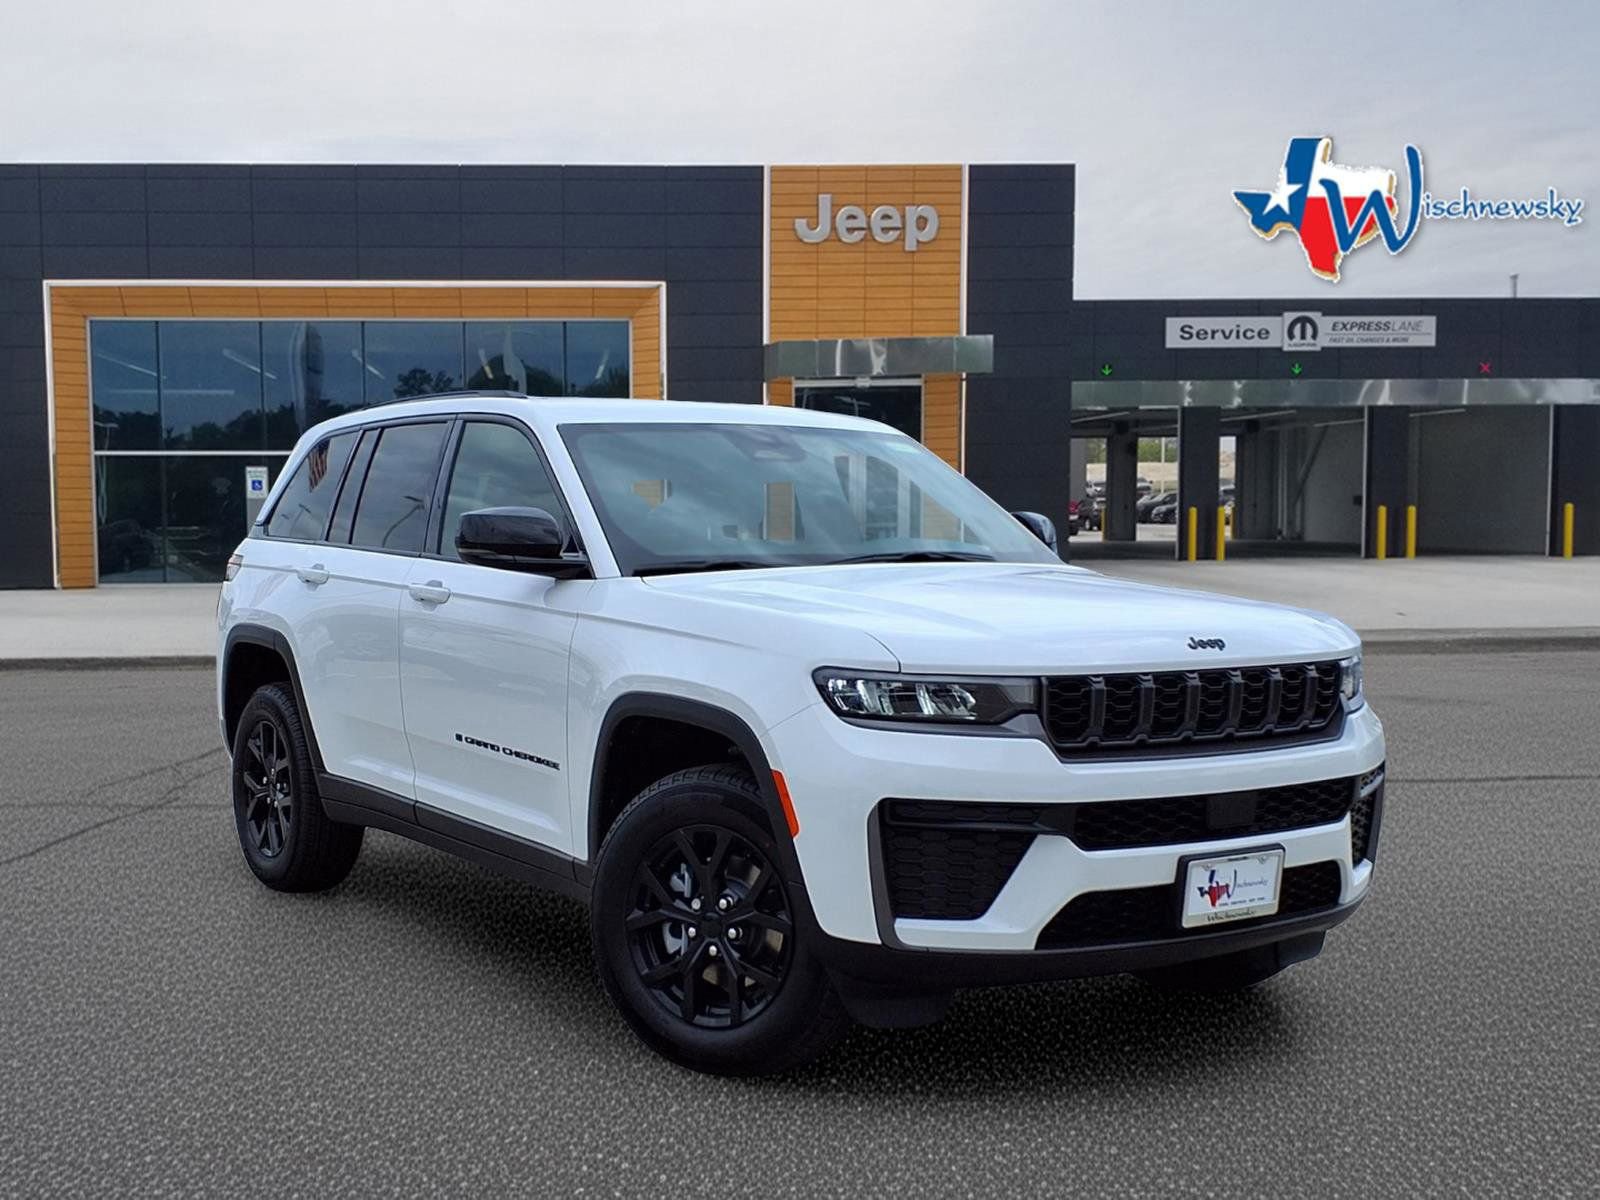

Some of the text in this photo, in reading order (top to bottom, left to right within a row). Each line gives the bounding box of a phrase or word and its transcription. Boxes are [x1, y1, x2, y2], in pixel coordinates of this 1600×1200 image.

[794, 193, 940, 252] Jeep
[1179, 323, 1271, 341] Service
[1187, 636, 1226, 652] Jeep
[464, 736, 501, 753] GRAND
